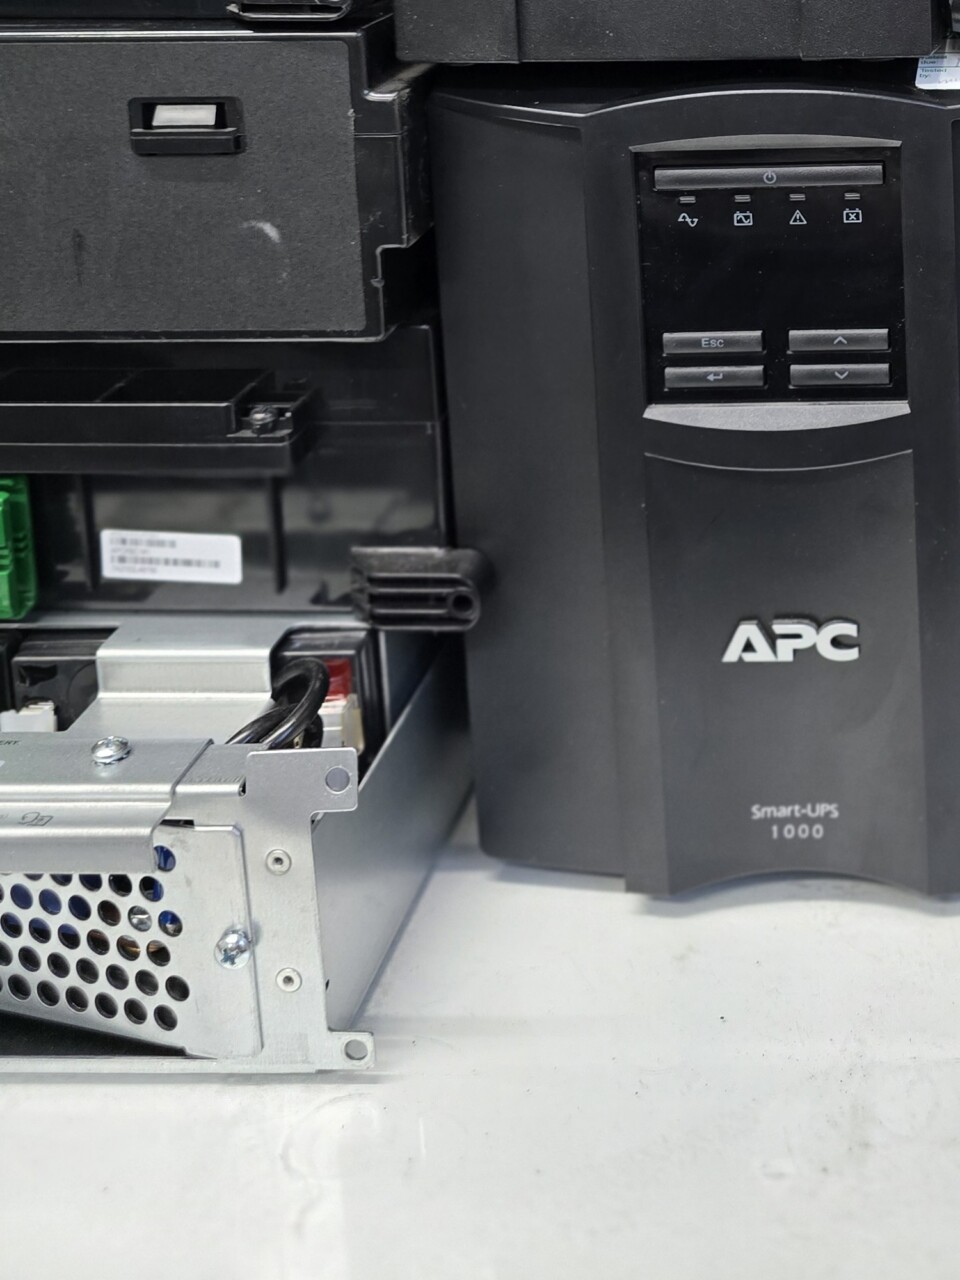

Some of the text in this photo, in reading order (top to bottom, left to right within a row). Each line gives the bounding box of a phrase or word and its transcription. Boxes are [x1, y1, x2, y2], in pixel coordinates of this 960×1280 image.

[701, 337, 725, 348] Esc
[721, 619, 860, 663] APC
[751, 803, 839, 819] Smart-UPS
[771, 824, 824, 839] 1000
